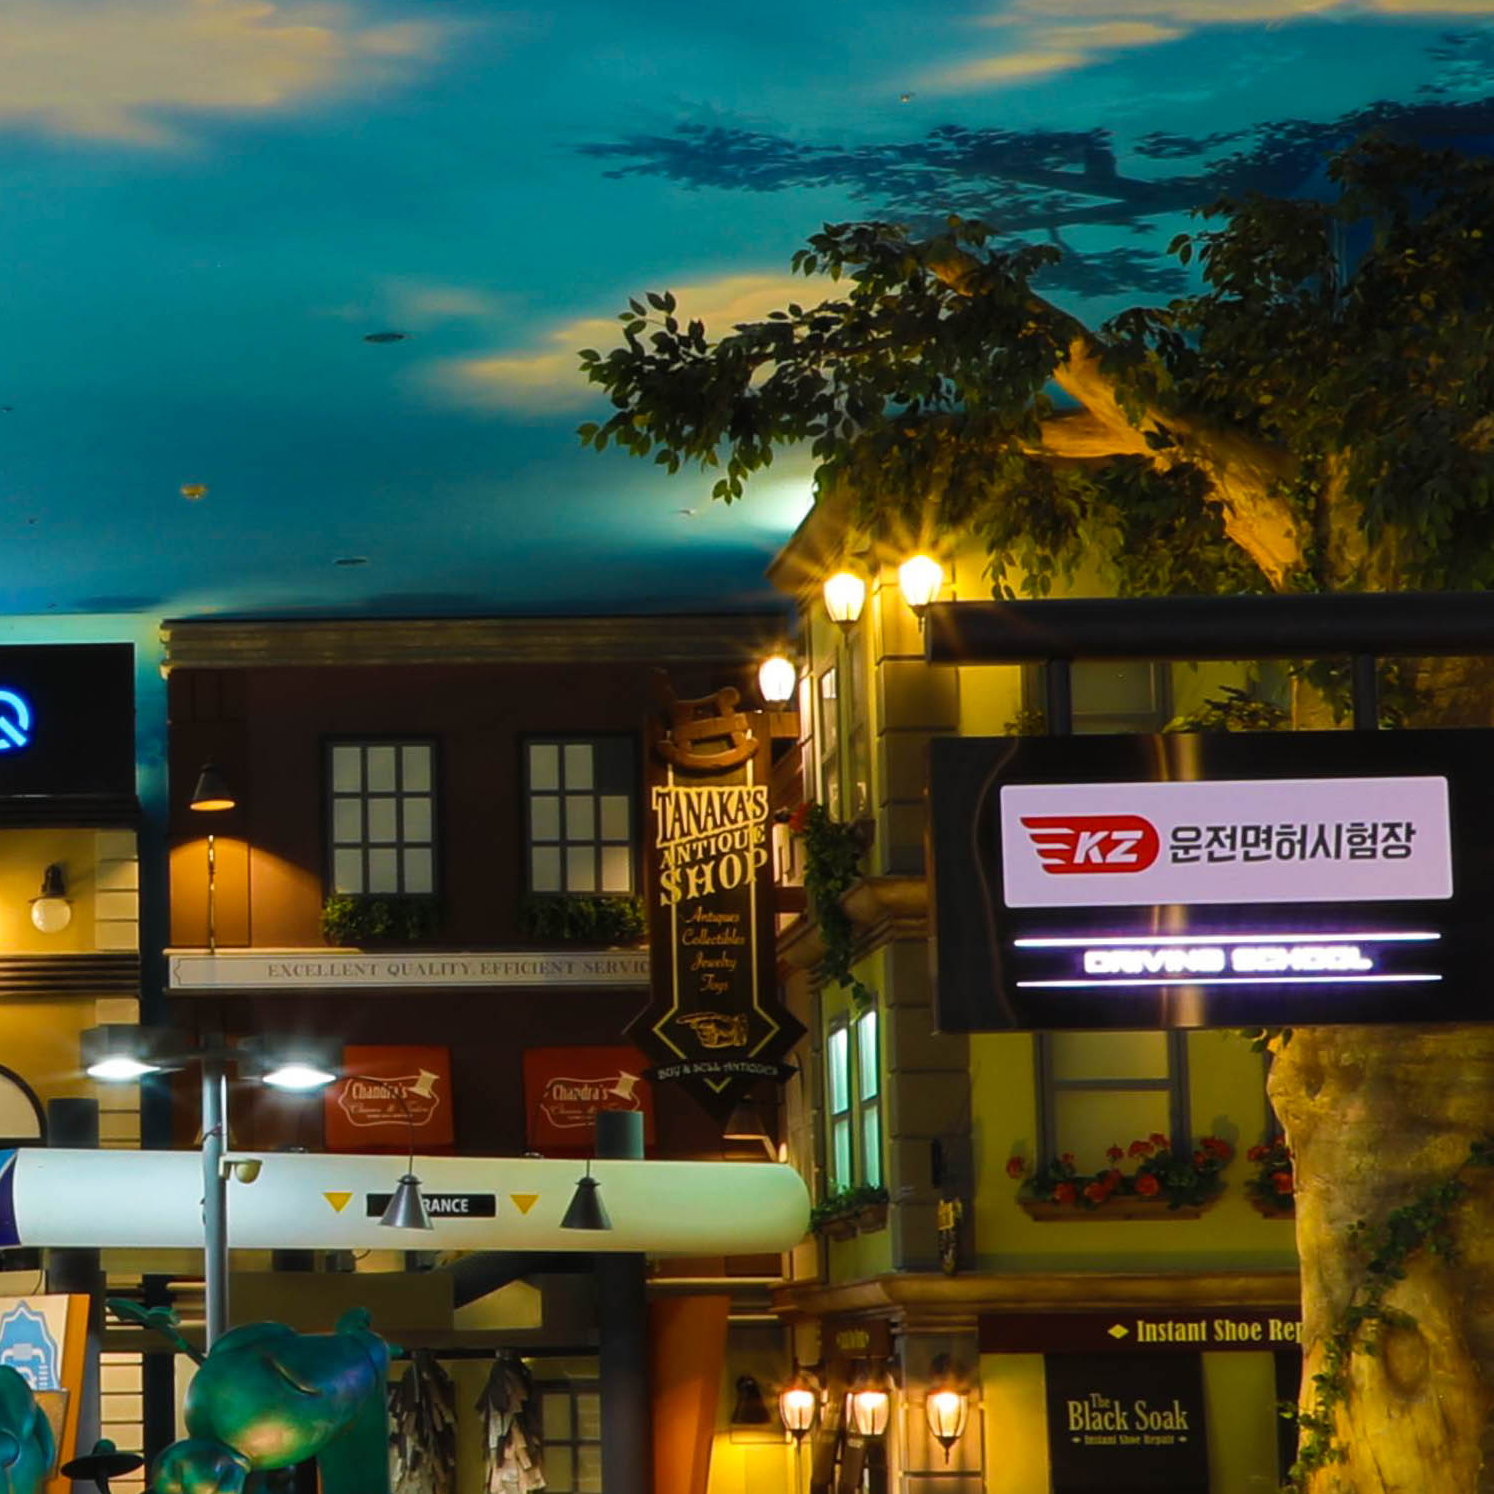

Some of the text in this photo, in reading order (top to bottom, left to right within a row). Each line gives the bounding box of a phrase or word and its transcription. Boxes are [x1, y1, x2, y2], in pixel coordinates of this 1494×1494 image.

[652, 786, 768, 848] TANAKA'S
[659, 826, 766, 869] ANTIQUE
[1072, 821, 1417, 864] KZ 운전면허시험장
[659, 847, 768, 906] SHOP
[681, 928, 746, 947] Collectibles
[267, 963, 378, 979] EXCELLENT
[479, 961, 575, 977] EFFICIENT
[1136, 1319, 1208, 1343] Instant
[1213, 1319, 1264, 1342] Shoe
[1089, 1393, 1111, 1409] The
[1067, 1399, 1190, 1432] Black Soak
[1084, 1434, 1175, 1446] Instant Shoe Repair
